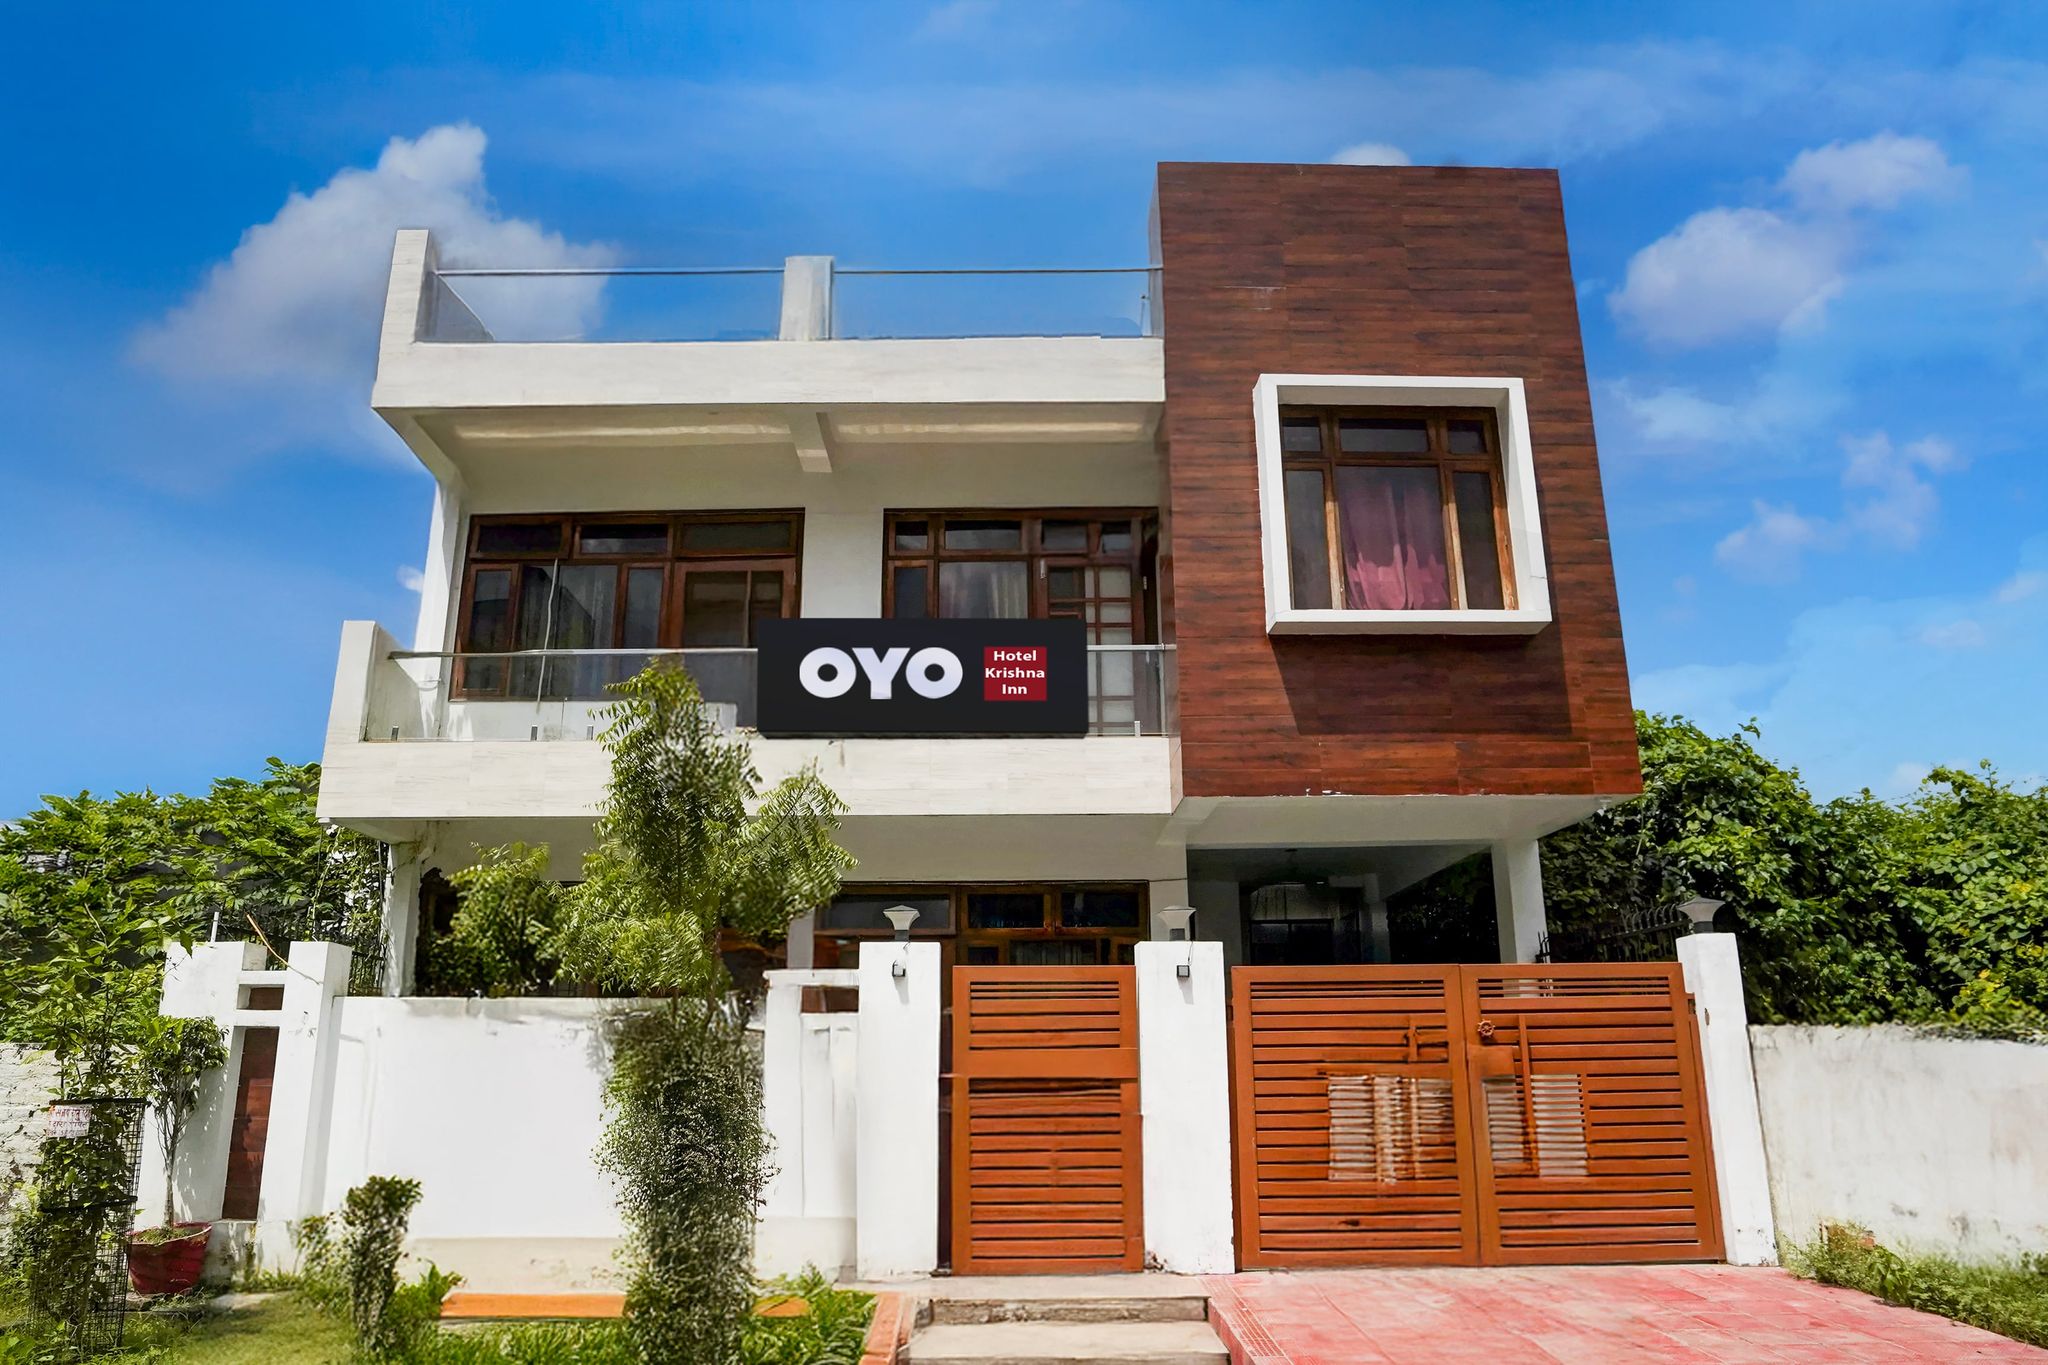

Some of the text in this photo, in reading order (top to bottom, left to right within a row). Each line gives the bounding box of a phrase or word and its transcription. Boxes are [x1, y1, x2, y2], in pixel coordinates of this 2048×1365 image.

[993, 650, 1037, 662] Hotel
[799, 646, 964, 700] OYO
[985, 667, 1045, 679] Krishna
[1002, 683, 1028, 695] Inn
